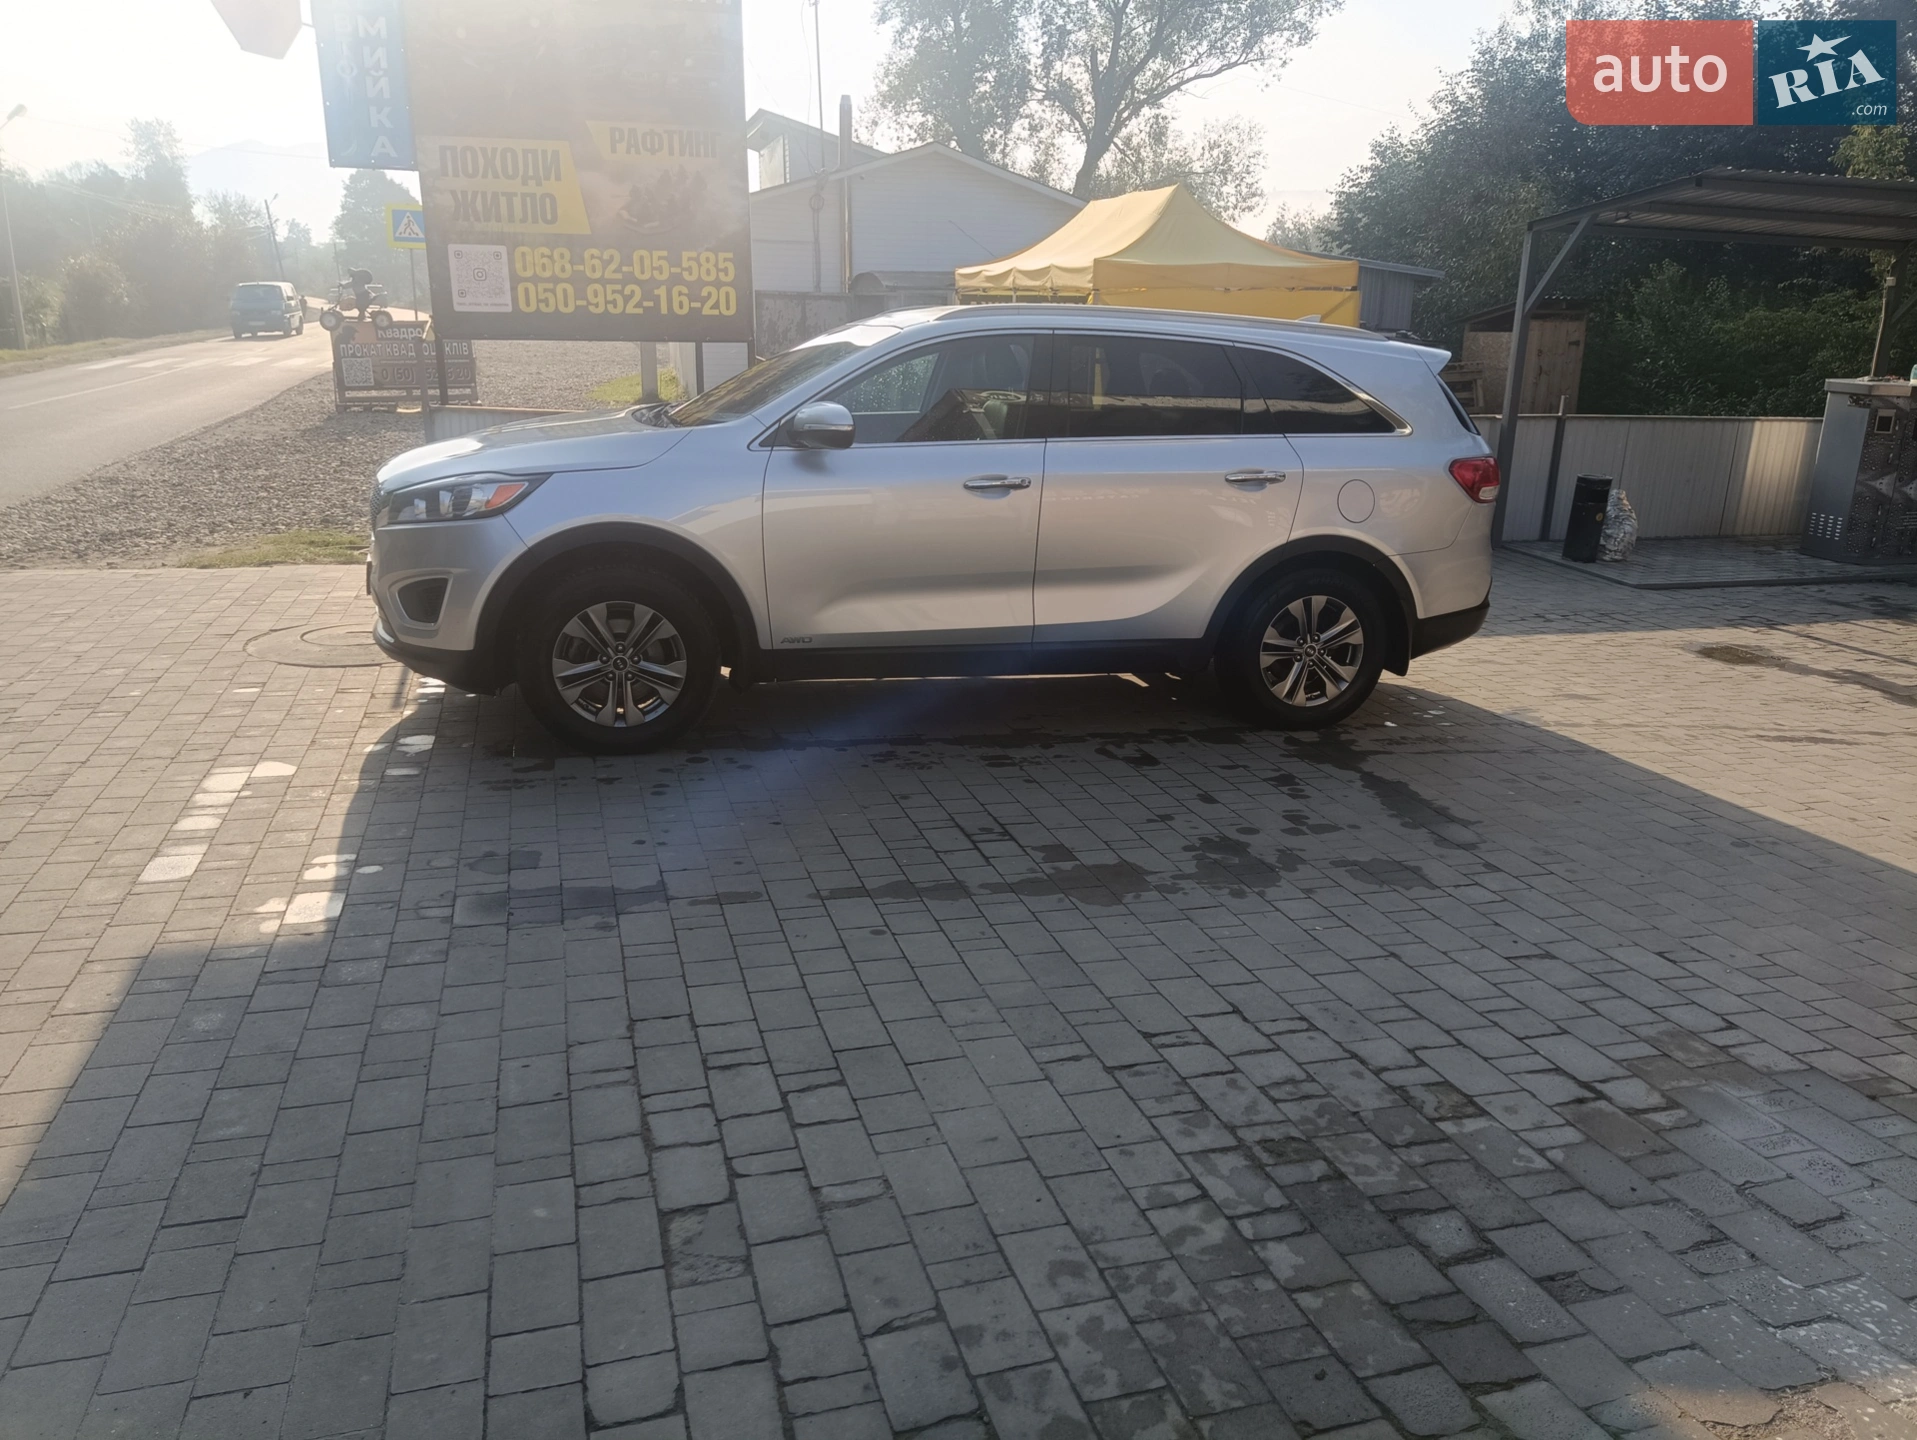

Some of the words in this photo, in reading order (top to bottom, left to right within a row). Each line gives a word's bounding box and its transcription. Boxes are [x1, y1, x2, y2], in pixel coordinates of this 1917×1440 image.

[356, 15, 398, 158] МИЙКА
[608, 126, 721, 159] РАФТИНГ
[438, 144, 562, 187] ПОХОДИ
[451, 190, 559, 226] ЖИТЛО
[514, 246, 736, 283] 068-62-05-585
[517, 282, 737, 316] 050-952-16-20
[340, 343, 383, 357] ПРОКАТ
